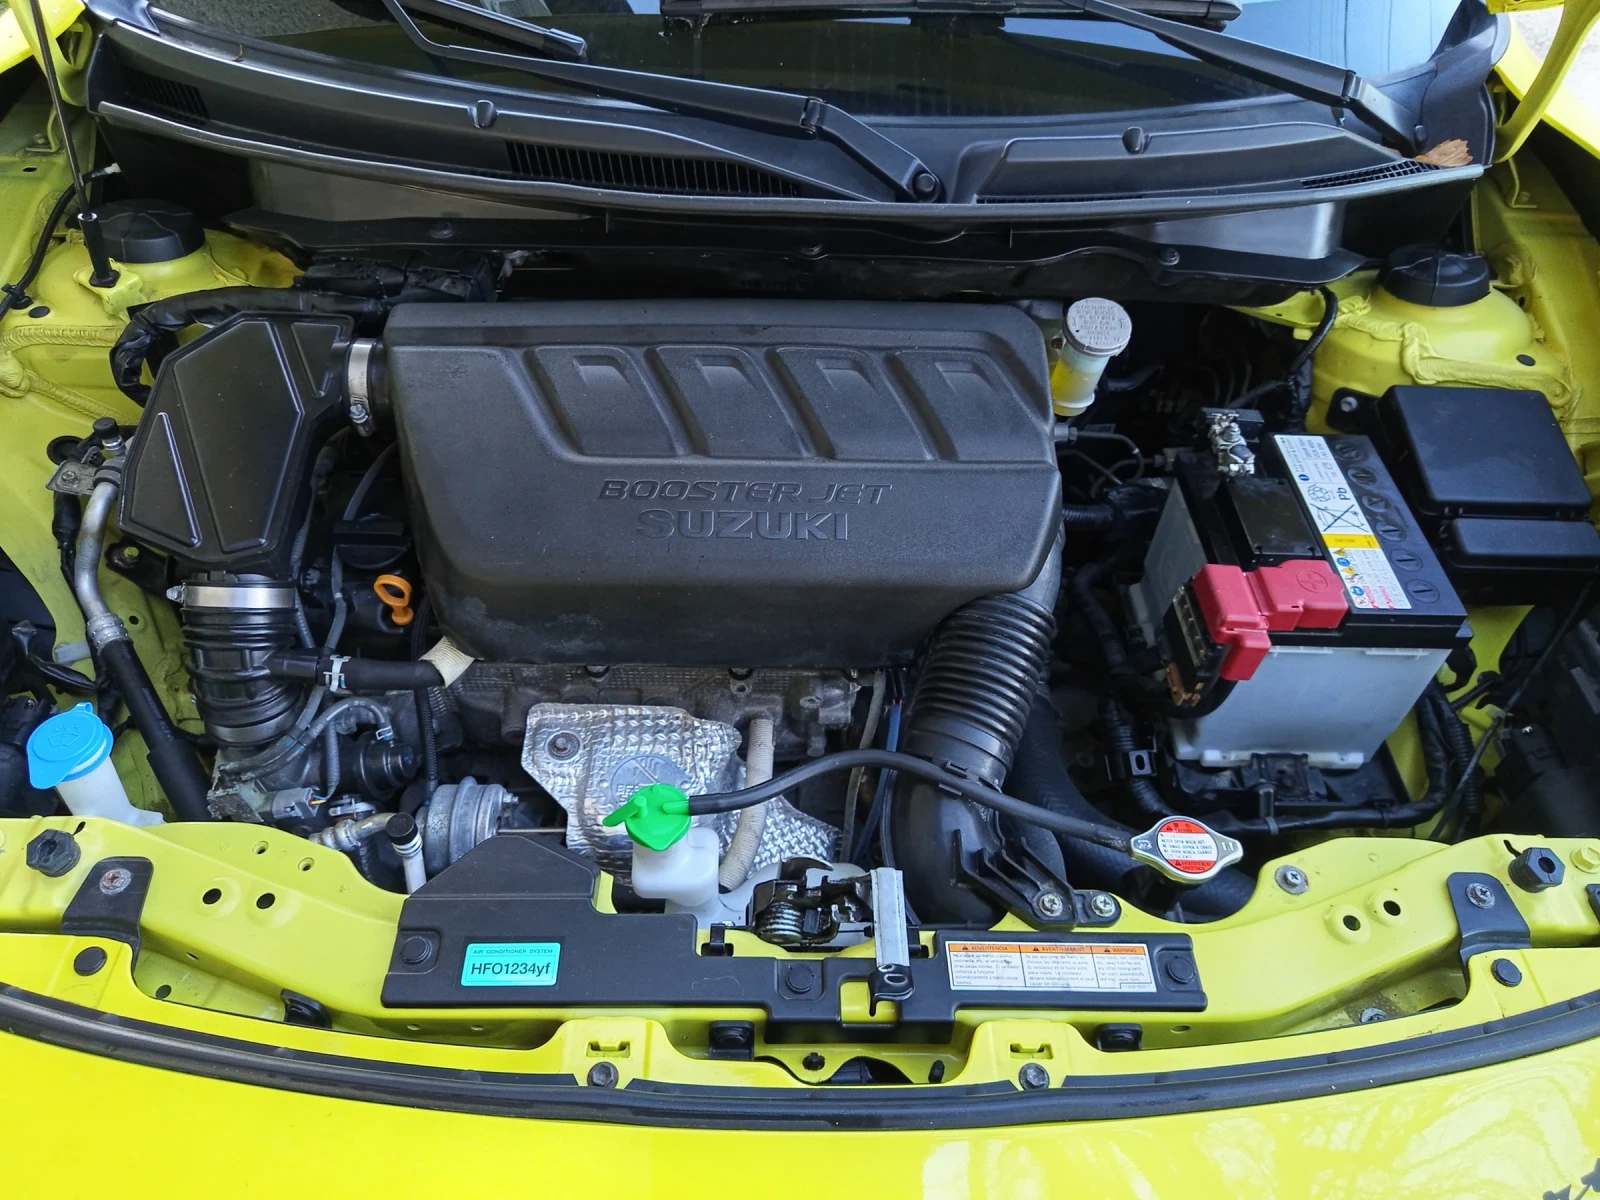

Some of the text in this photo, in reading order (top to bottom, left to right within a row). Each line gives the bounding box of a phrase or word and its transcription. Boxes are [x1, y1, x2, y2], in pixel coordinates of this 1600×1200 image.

[600, 479, 893, 505] BOOSTER JET
[637, 508, 848, 541] SUZUKI
[471, 962, 551, 978] HFO1234yf
